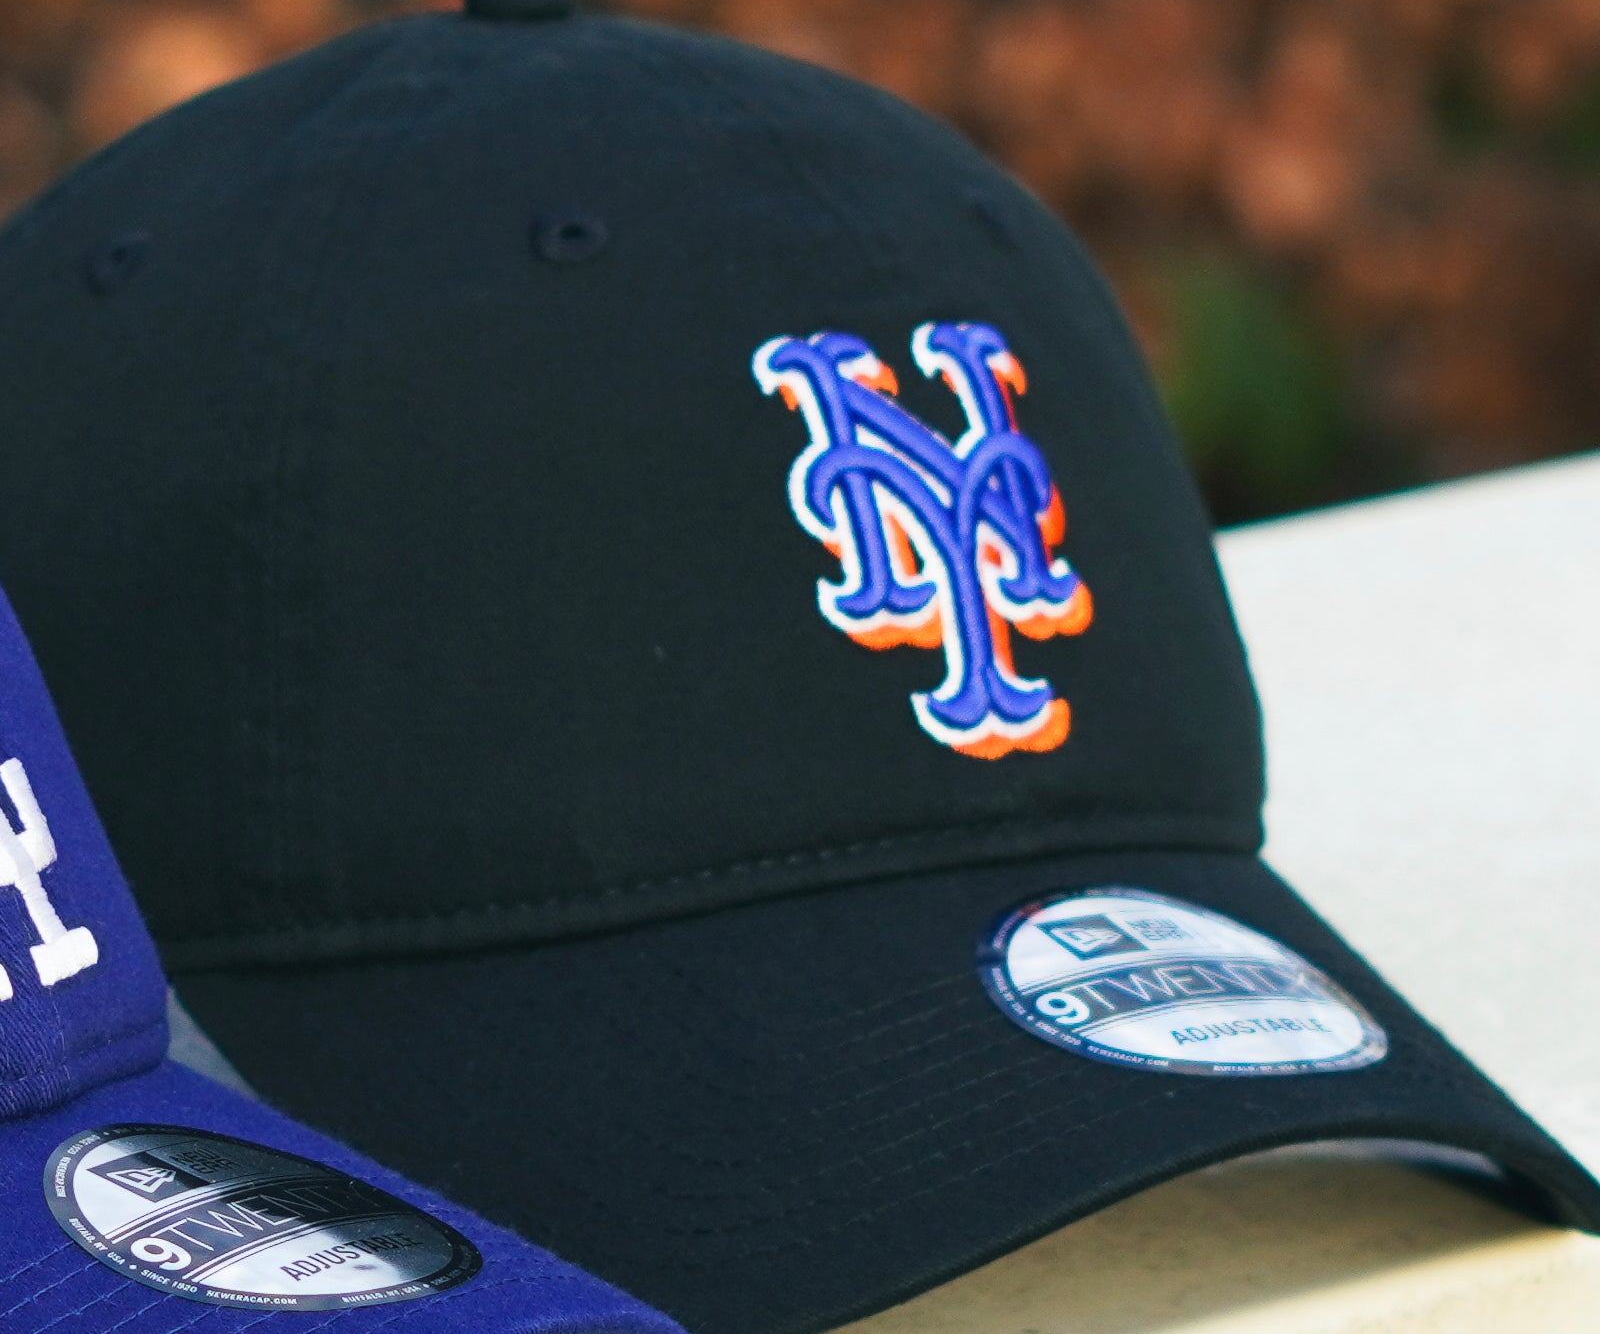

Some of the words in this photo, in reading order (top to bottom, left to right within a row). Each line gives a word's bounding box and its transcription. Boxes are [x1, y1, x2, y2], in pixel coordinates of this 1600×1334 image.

[751, 320, 1093, 760] NY
[1171, 1018, 1333, 1046] ADJUSTABLE
[107, 1251, 126, 1266] USA
[280, 1233, 424, 1281] ADJUSTABLE
[140, 1269, 170, 1286] SINCE
[206, 1289, 298, 1305] NEWERACAP.COM
